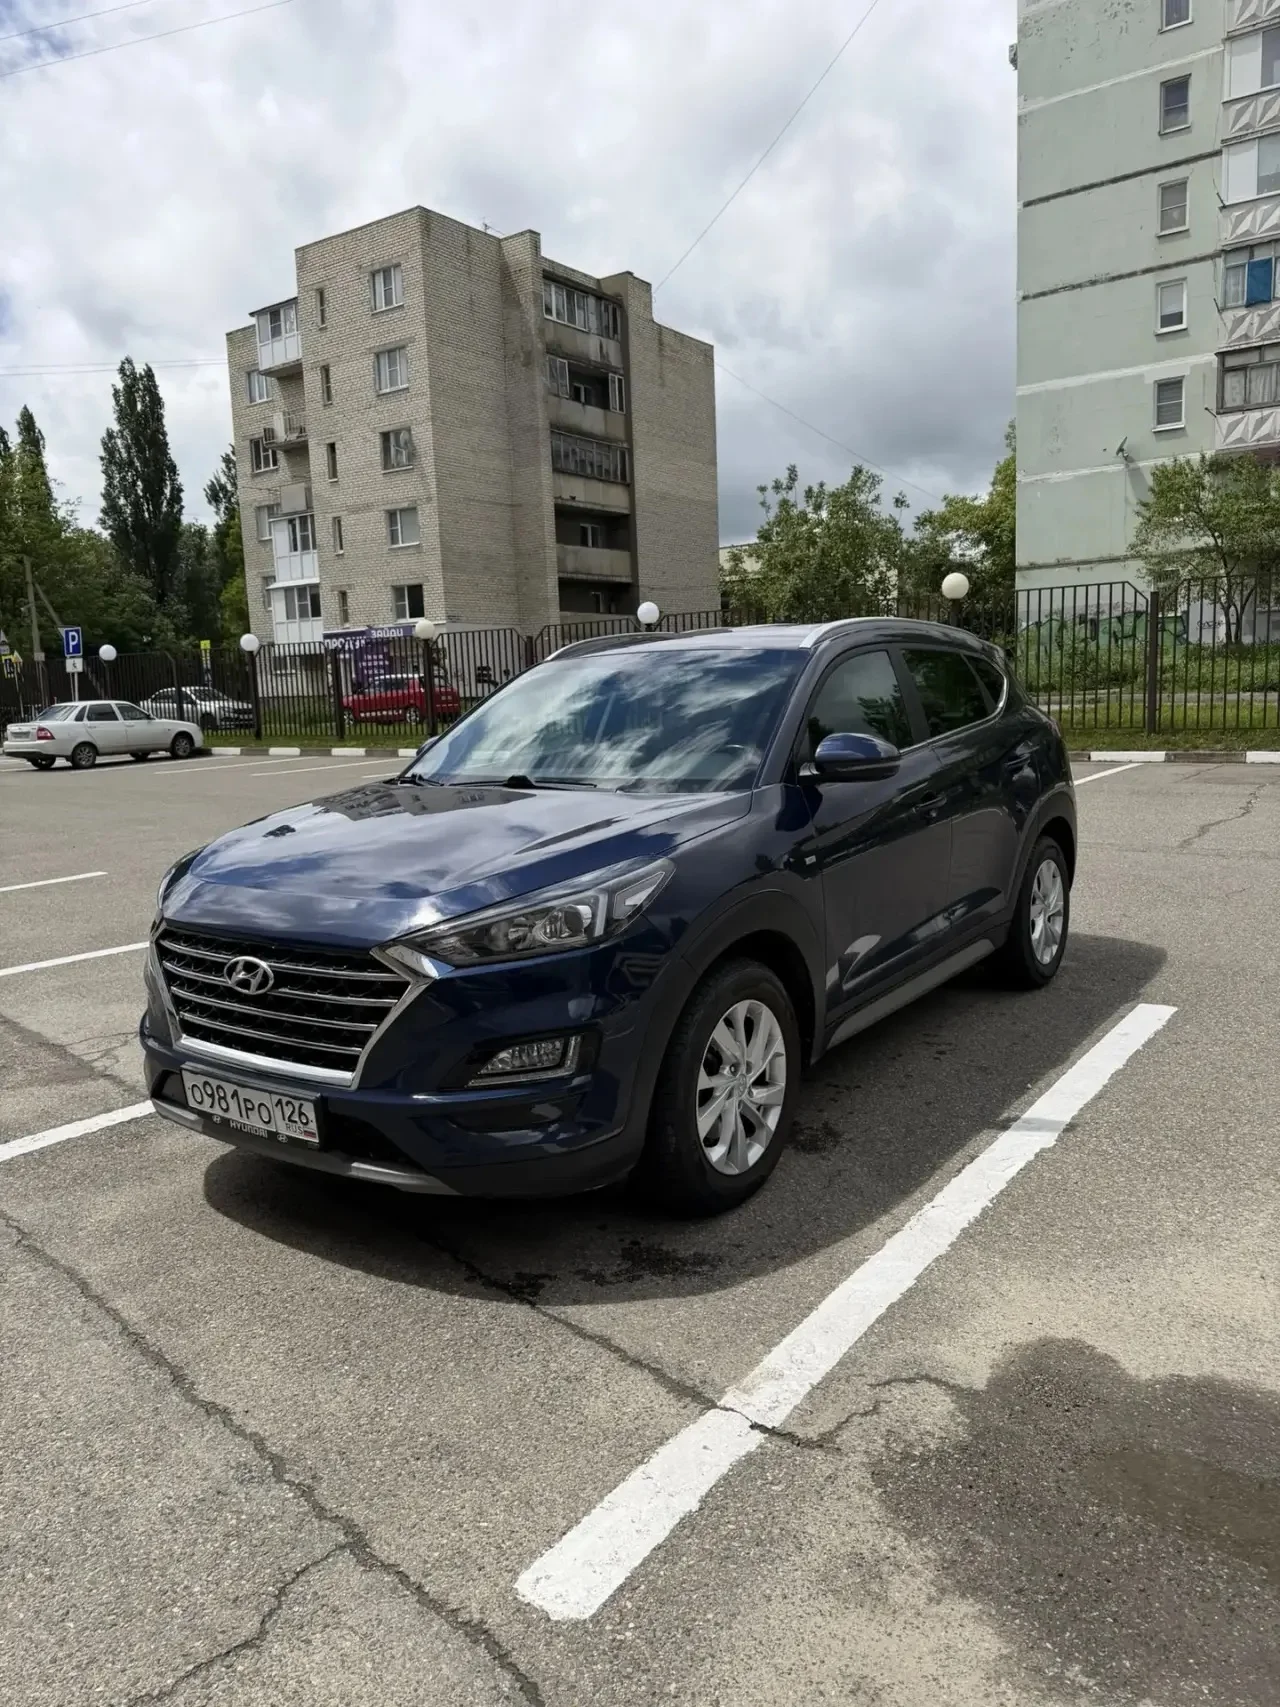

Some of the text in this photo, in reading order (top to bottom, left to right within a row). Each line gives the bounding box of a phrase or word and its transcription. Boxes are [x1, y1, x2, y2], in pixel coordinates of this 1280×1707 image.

[69, 631, 79, 653] P
[275, 1098, 309, 1126] 126
[229, 1119, 268, 1139] HYUNDAI
[286, 1122, 304, 1135] RUS
